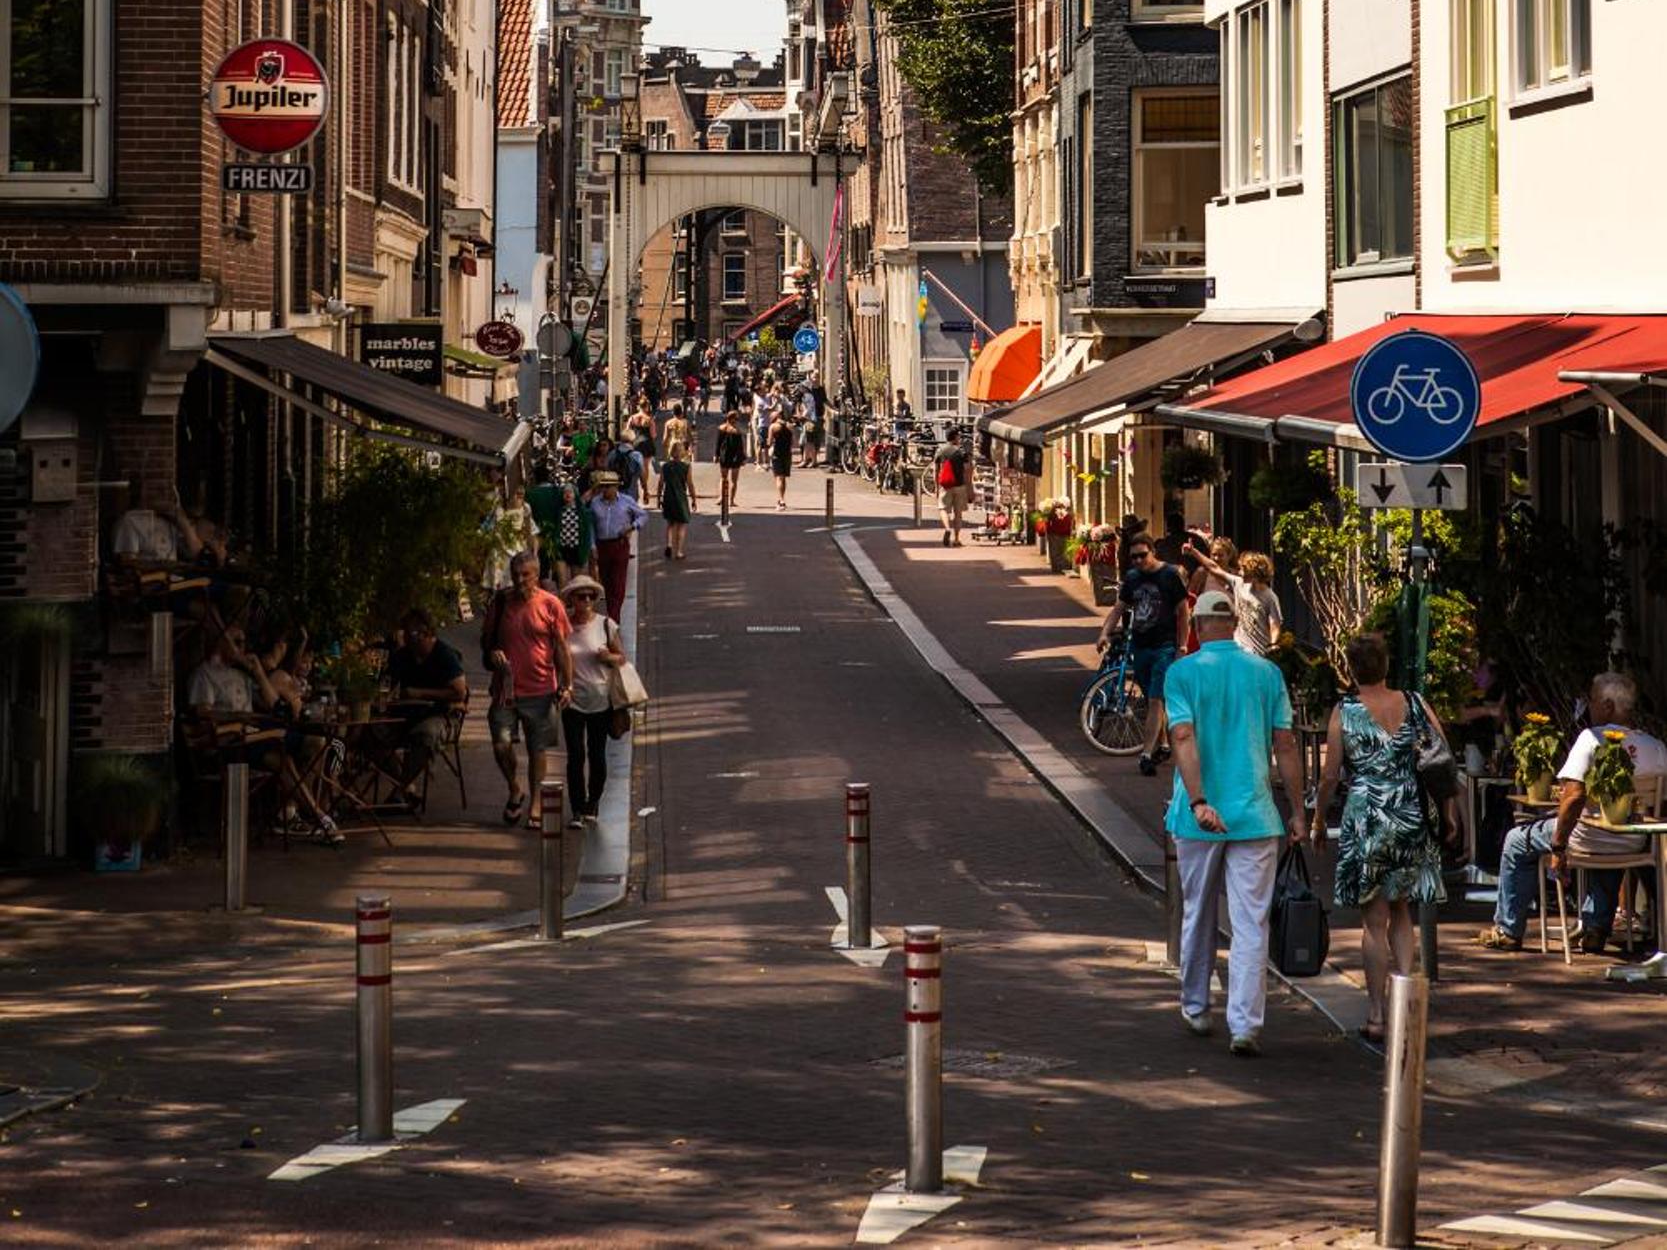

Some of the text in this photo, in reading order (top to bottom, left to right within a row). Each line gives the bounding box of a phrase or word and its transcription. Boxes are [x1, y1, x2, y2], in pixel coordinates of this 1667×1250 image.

[221, 85, 318, 112] Jupiler
[228, 168, 306, 190] FRENZI
[366, 337, 436, 350] marbles
[368, 355, 433, 372] vintage
